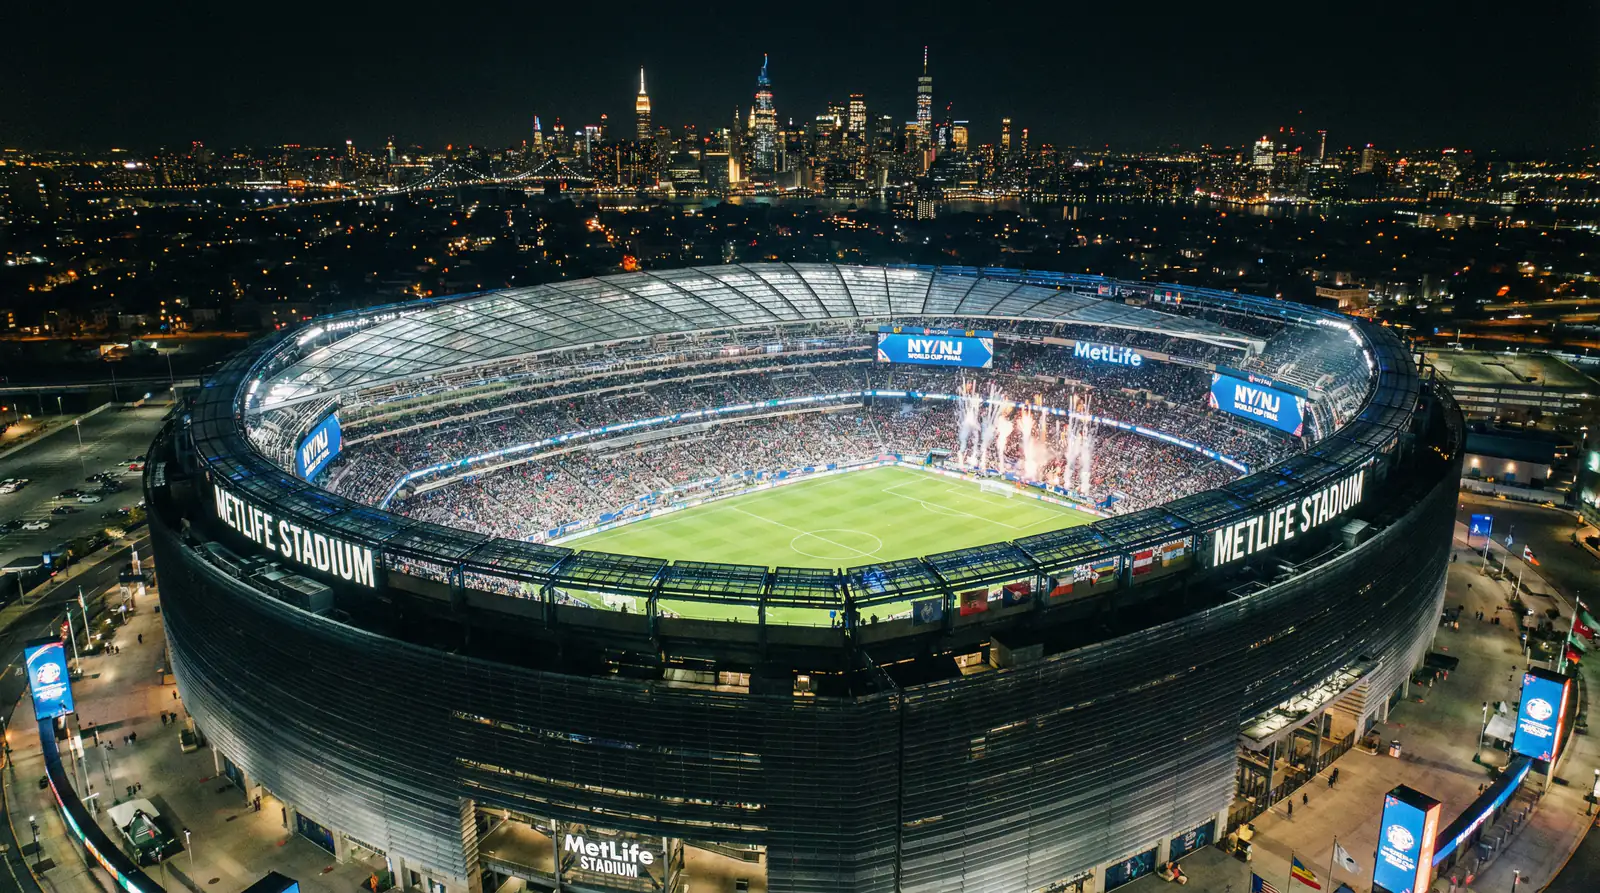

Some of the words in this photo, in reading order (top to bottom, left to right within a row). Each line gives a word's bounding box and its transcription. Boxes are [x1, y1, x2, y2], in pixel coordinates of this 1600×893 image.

[908, 339, 962, 355] NY/NJ
[1074, 341, 1141, 366] MetLife
[1235, 384, 1280, 413] NY/NJ
[1213, 503, 1296, 566] METLIFE
[1300, 470, 1364, 532] STADIUM
[214, 485, 275, 550] METLIFE
[279, 520, 374, 587] STADIUM
[565, 834, 653, 864] MetLife
[580, 856, 637, 877] STADIUM
